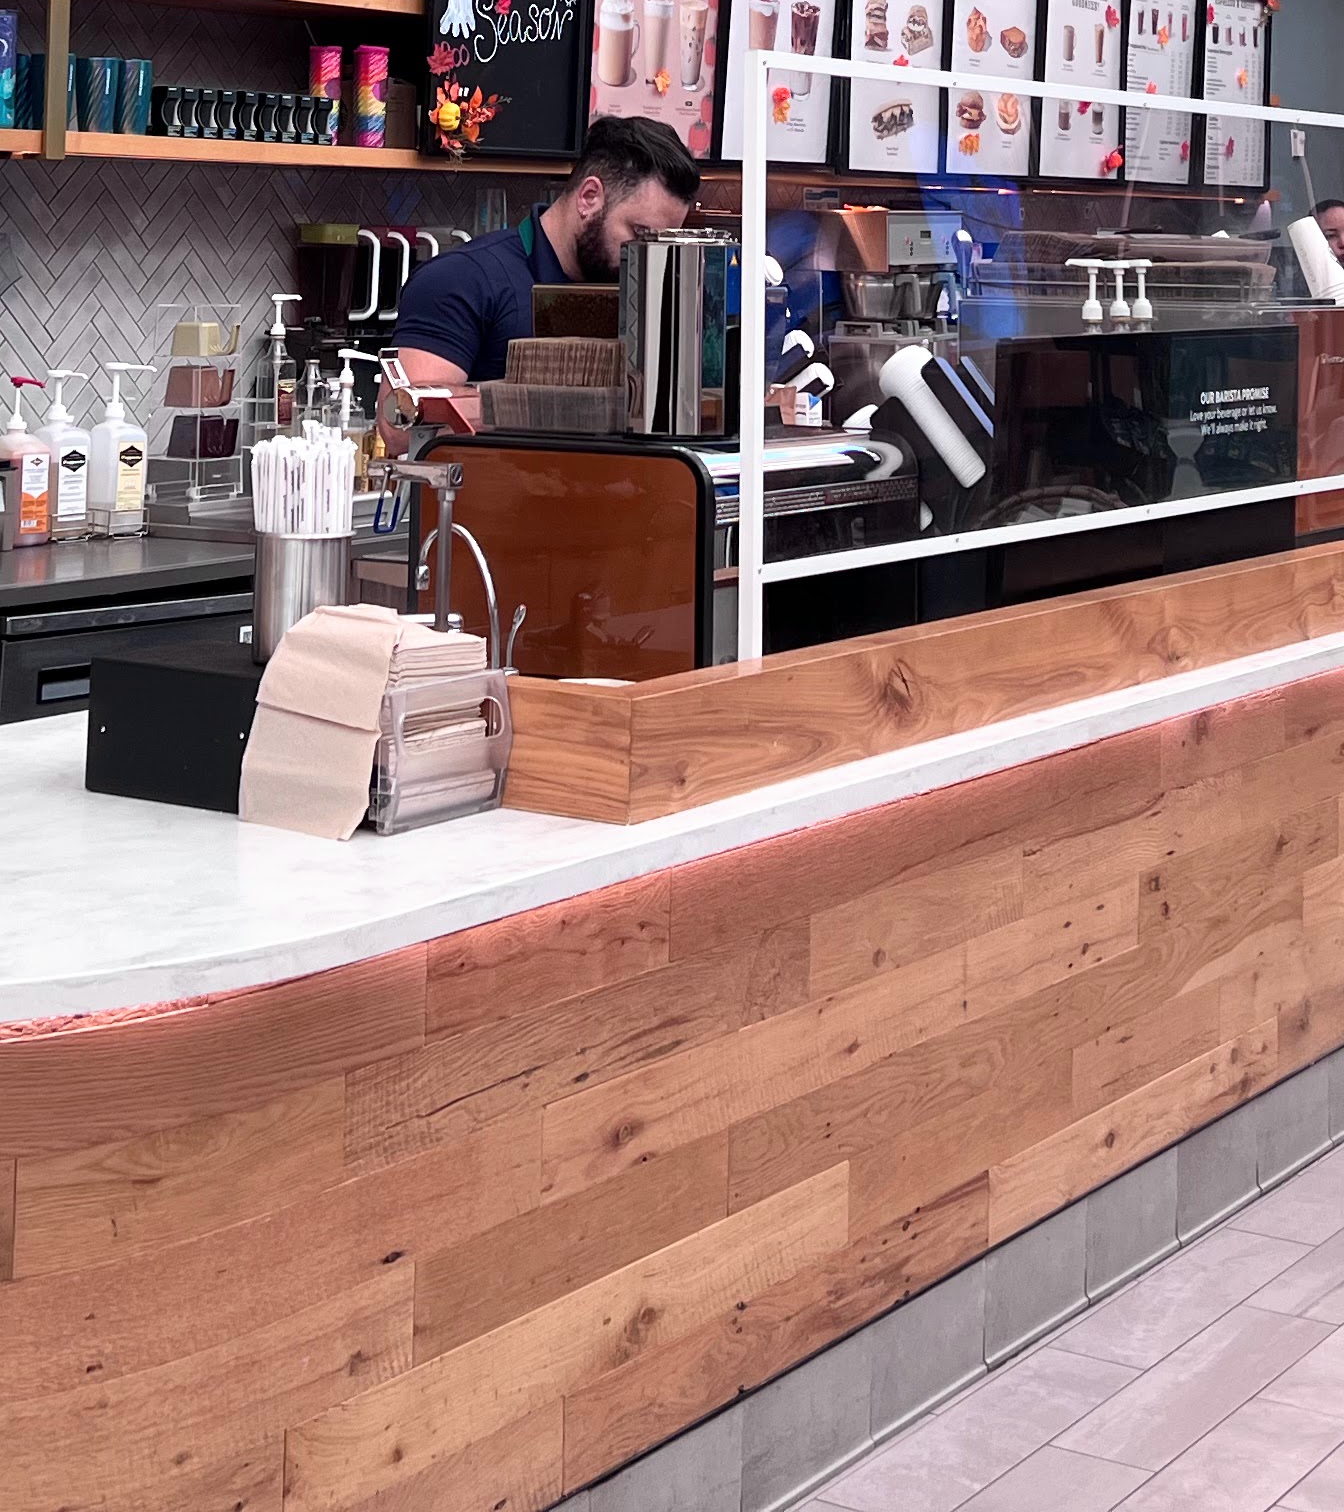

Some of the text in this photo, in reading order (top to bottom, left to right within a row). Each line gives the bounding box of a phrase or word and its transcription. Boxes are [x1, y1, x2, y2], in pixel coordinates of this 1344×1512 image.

[1200, 386, 1270, 405] OUR BARISTA PROMISE
[1189, 409, 1204, 422] Love
